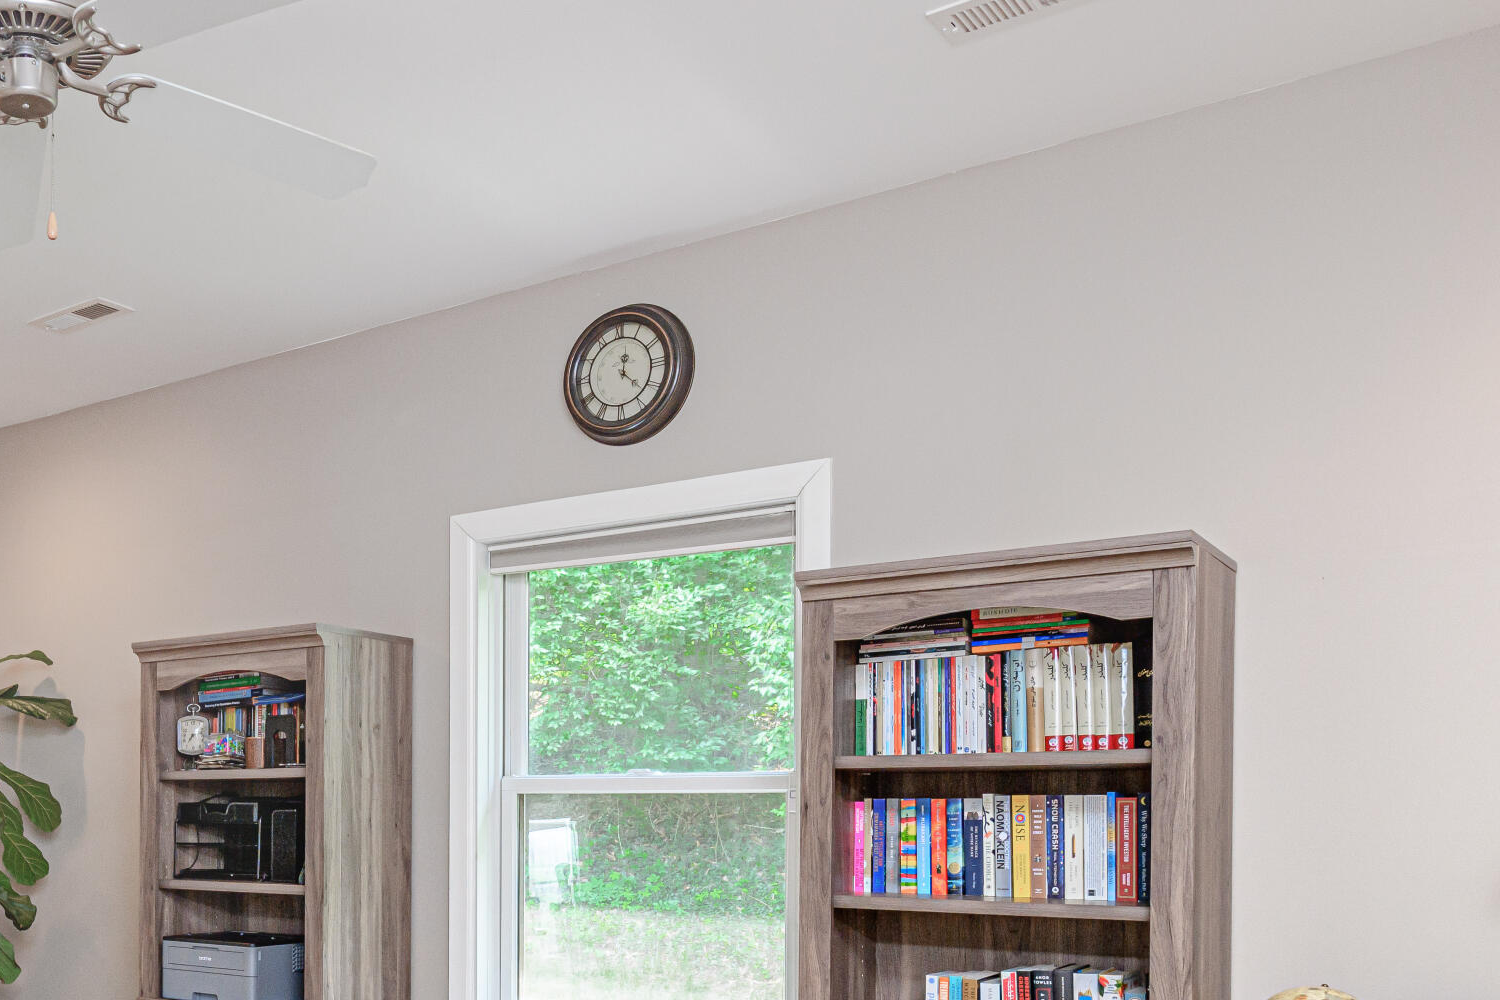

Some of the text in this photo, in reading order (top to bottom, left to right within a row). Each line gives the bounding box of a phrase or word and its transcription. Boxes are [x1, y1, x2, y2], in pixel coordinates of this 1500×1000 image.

[1047, 662, 1055, 681] کلیدر
[1062, 661, 1070, 679] کلیدر
[1097, 660, 1105, 679] کلیدر
[996, 800, 1004, 833] NAOMI
[1142, 824, 1147, 832] We
[1140, 833, 1148, 847] Sleep
